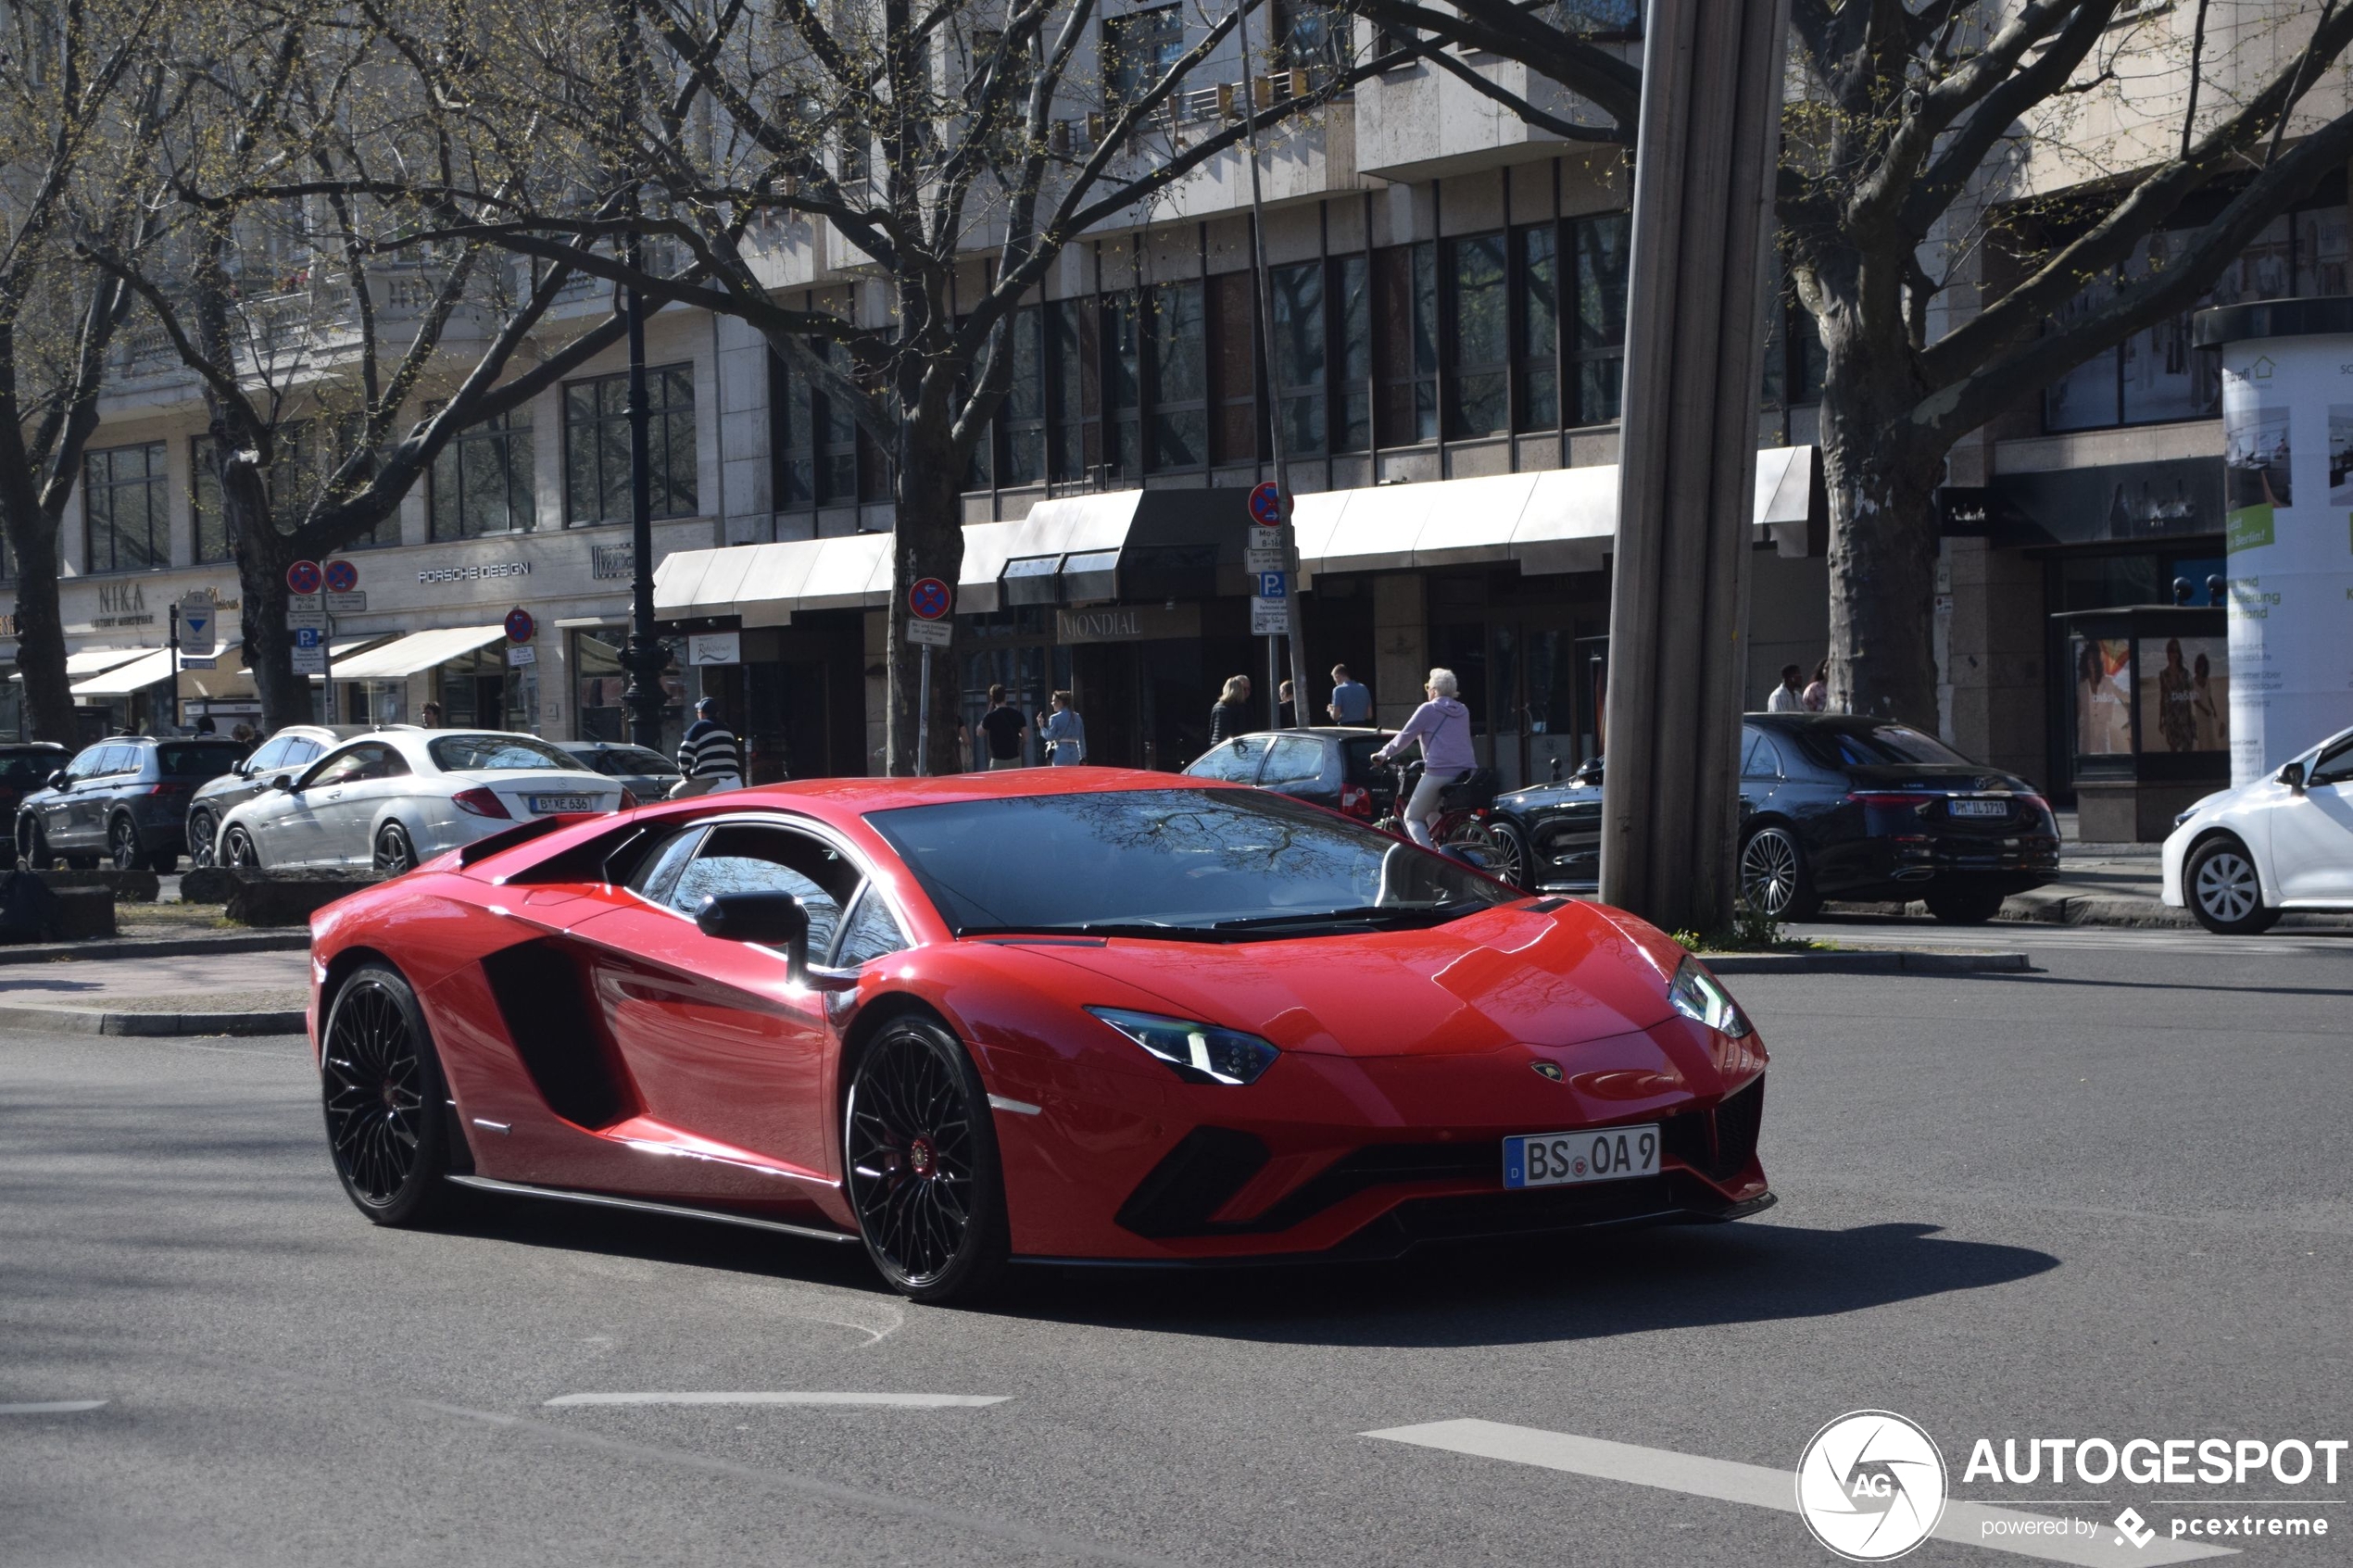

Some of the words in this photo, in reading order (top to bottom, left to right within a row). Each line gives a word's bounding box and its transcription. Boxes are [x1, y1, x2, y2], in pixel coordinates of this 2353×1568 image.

[1259, 529, 1282, 537] Mo-S
[2234, 529, 2265, 546] Berlin!
[419, 567, 479, 583] PORSCHE
[481, 562, 531, 579] DESIGN
[99, 584, 145, 613] NIKA
[1063, 612, 1141, 637] MONDIAL
[540, 799, 547, 809] B
[554, 799, 567, 809] XE
[569, 797, 587, 809] 636
[1984, 801, 2005, 814] 1719
[1528, 1139, 1569, 1181] BS
[1592, 1135, 1631, 1174] OA
[1639, 1132, 1656, 1170] 9
